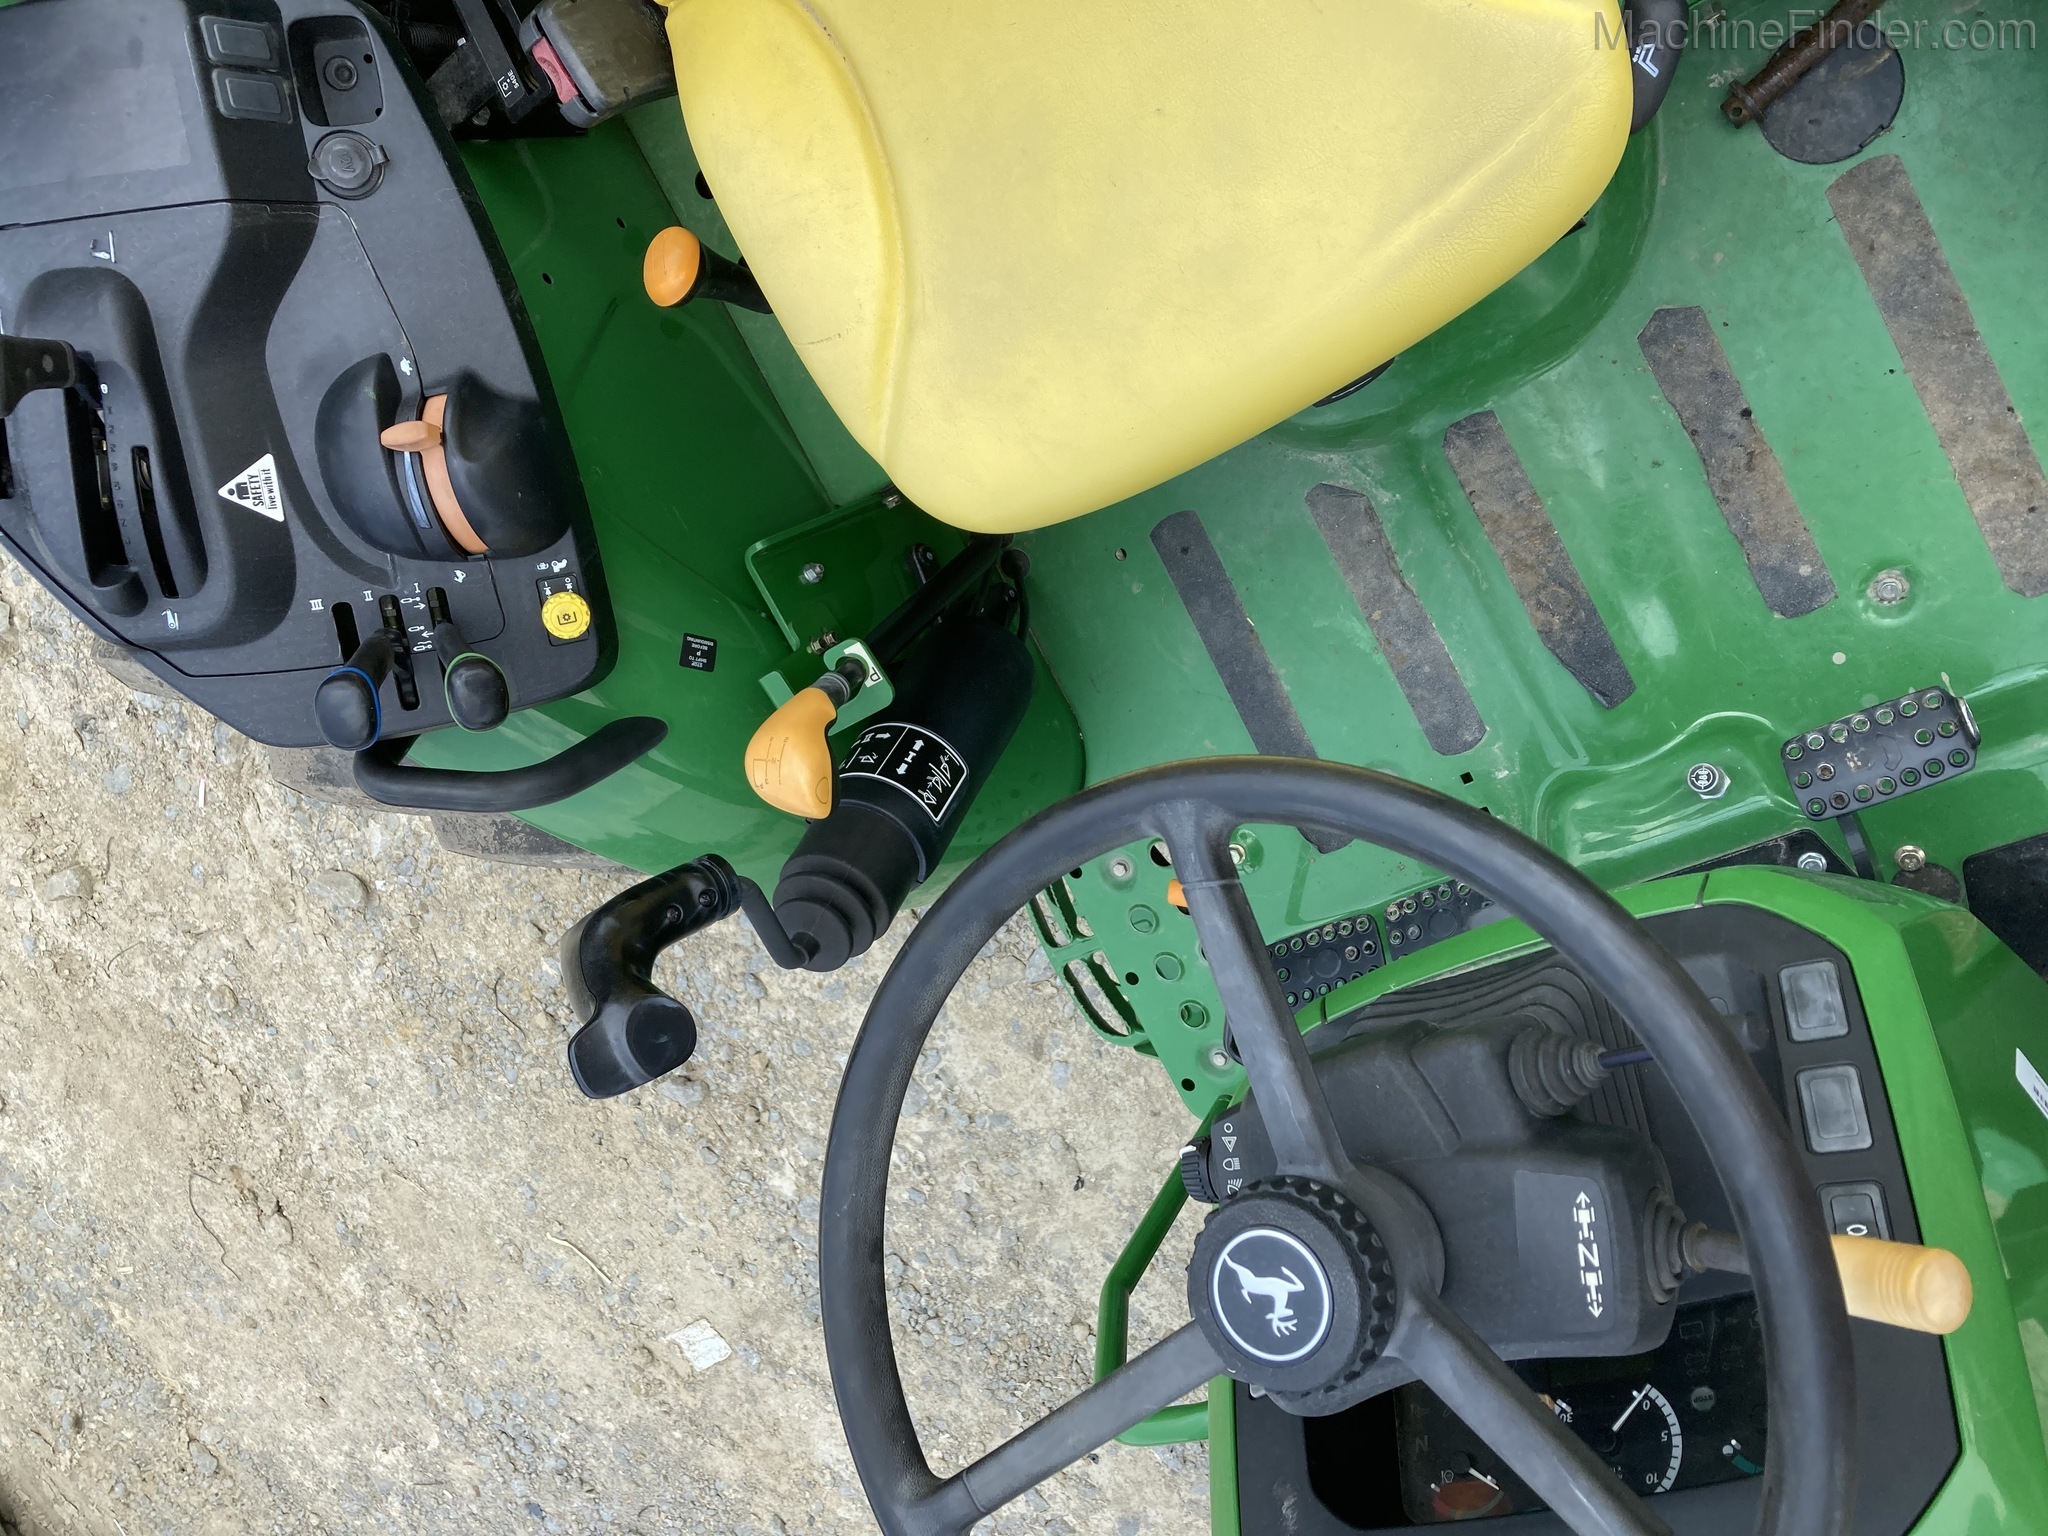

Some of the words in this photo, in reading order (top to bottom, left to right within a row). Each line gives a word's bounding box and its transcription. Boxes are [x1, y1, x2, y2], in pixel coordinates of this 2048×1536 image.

[247, 474, 265, 507] SAFETY
[262, 476, 276, 495] with
[266, 494, 278, 510] live
[870, 666, 882, 682] P
[1577, 1243, 1600, 1267] N
[1642, 1400, 1651, 1411] 0
[1660, 1430, 1669, 1442] 5
[1645, 1472, 1659, 1485] 10
